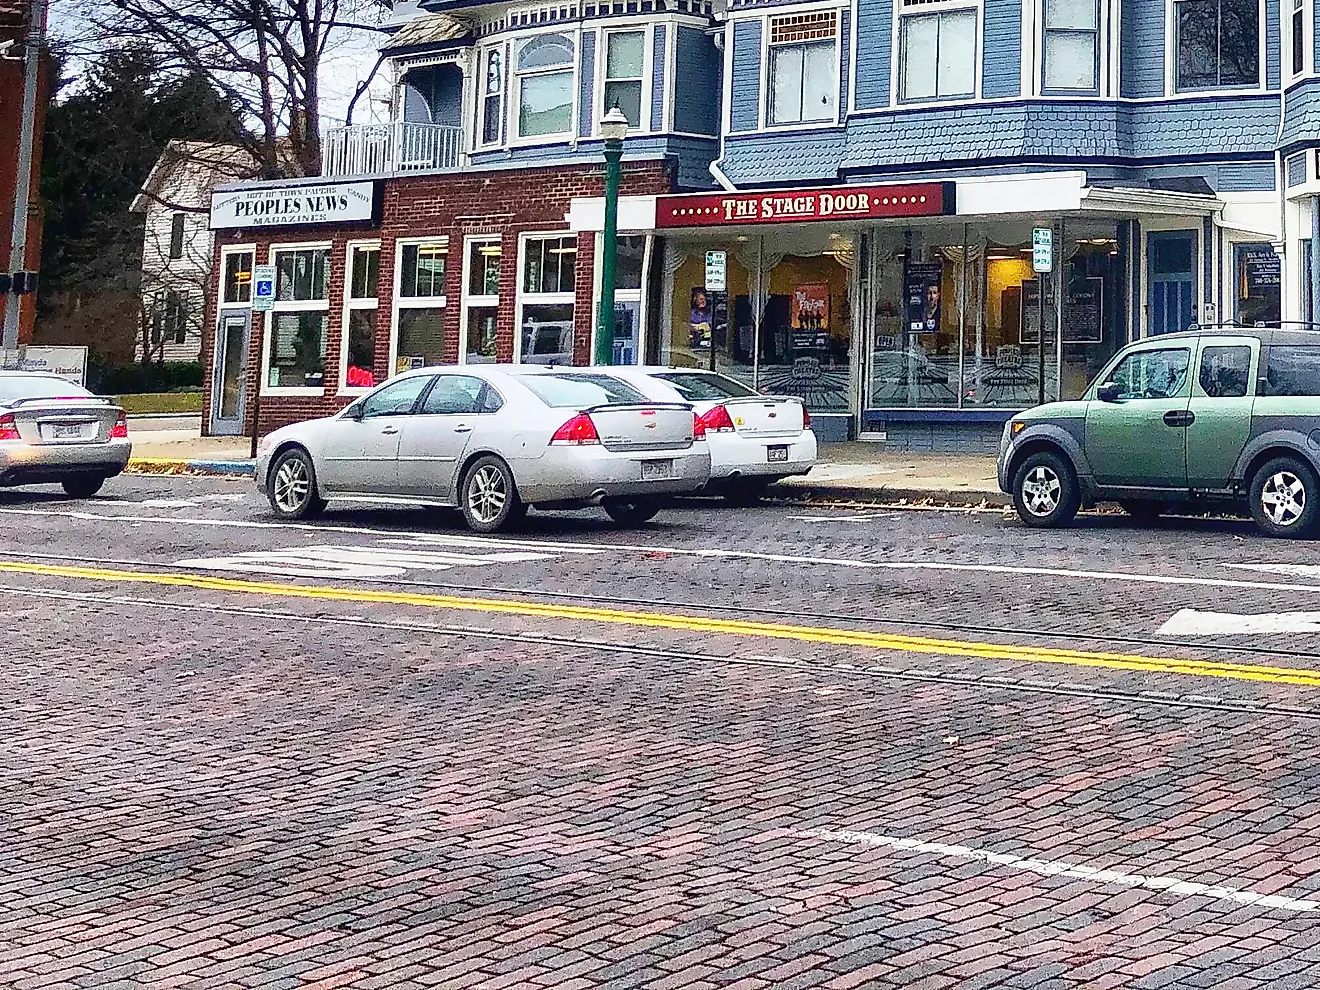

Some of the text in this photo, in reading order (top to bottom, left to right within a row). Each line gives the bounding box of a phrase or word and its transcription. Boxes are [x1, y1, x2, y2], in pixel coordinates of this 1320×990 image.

[279, 189, 302, 197] TOWN
[305, 187, 337, 195] PAPERS
[234, 195, 348, 217] PEOPLES NEWS
[722, 194, 870, 219] THE STAGE DOOR
[252, 214, 327, 224] MAGAZINES
